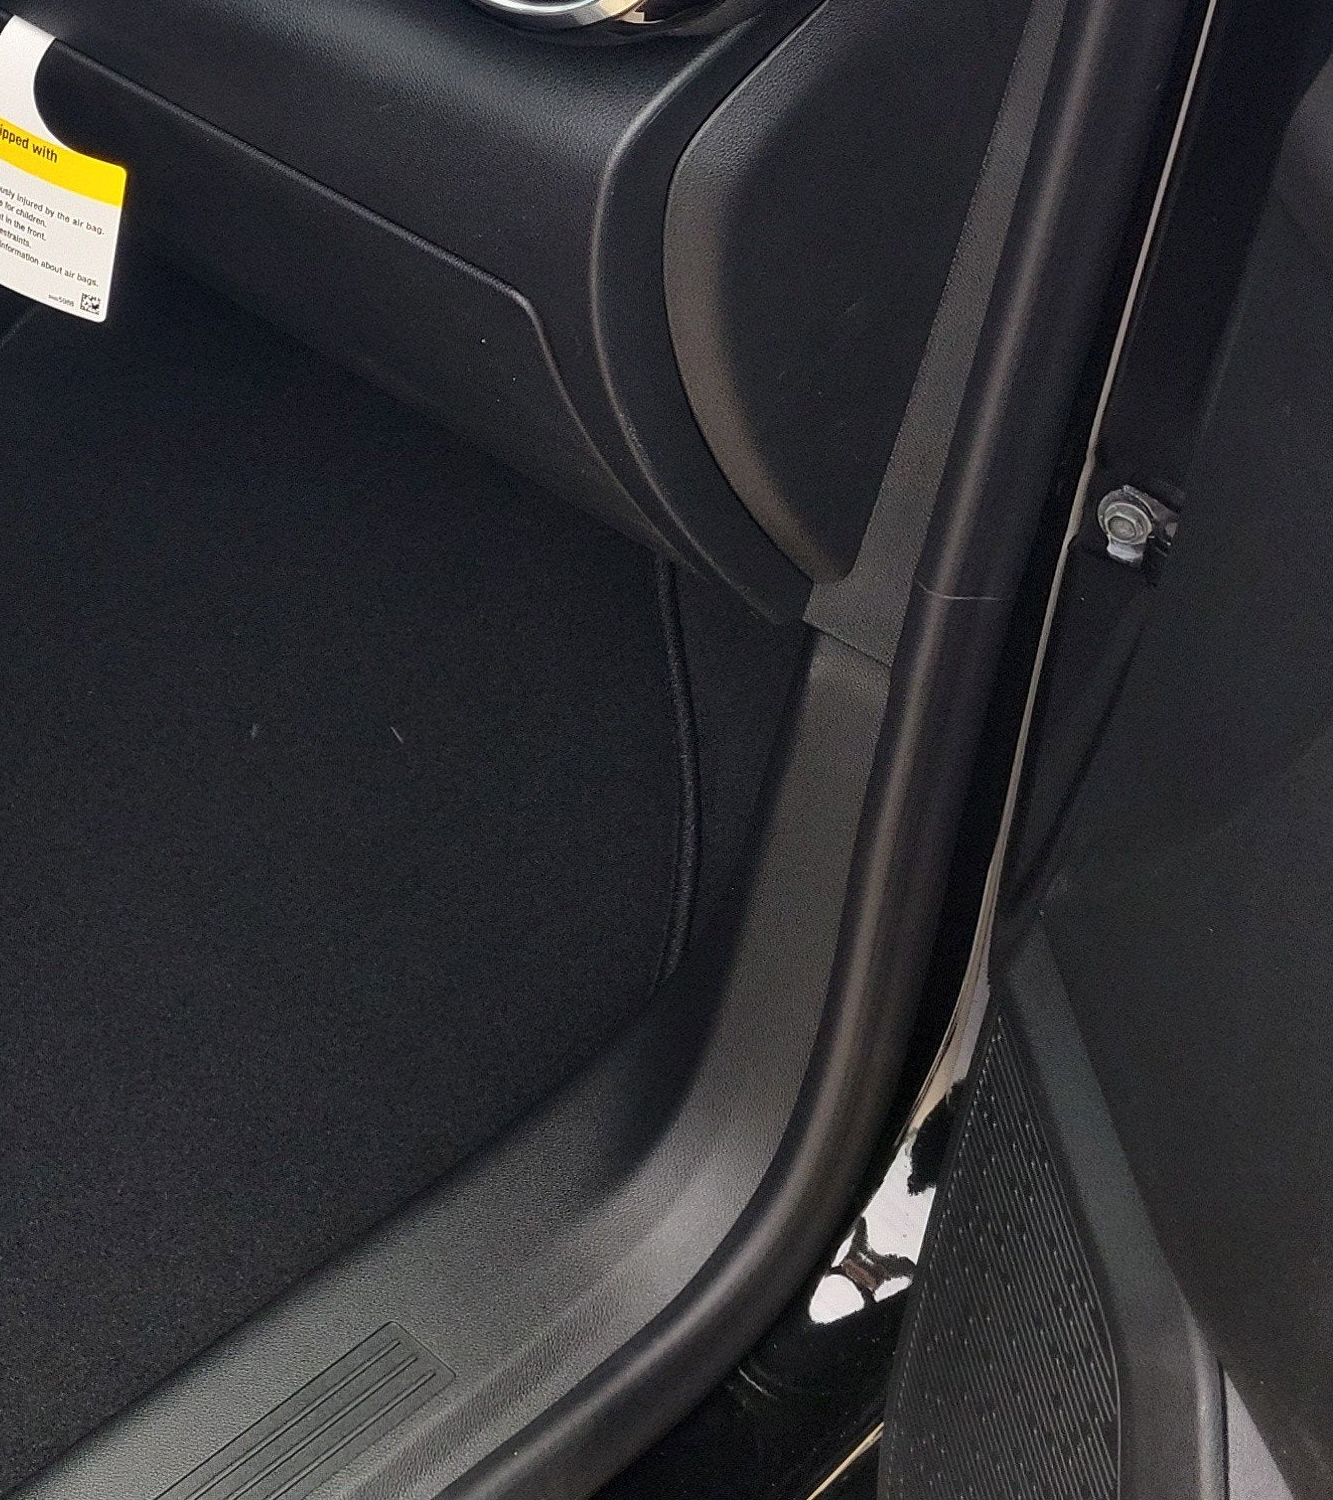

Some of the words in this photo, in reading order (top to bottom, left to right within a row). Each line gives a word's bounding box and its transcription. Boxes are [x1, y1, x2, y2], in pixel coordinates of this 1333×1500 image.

[33, 143, 57, 163] with
[5, 202, 15, 211] for
[16, 208, 47, 228] children.
[16, 193, 43, 212] injured
[45, 206, 55, 217] by
[57, 211, 70, 223] the
[72, 217, 84, 228] air
[86, 222, 105, 235] bag.
[5, 216, 12, 225] in
[13, 220, 25, 231] the
[27, 226, 46, 241] front.
[0, 240, 39, 265] information
[41, 260, 63, 274] about
[64, 268, 75, 278] air
[76, 274, 99, 287] bags.
